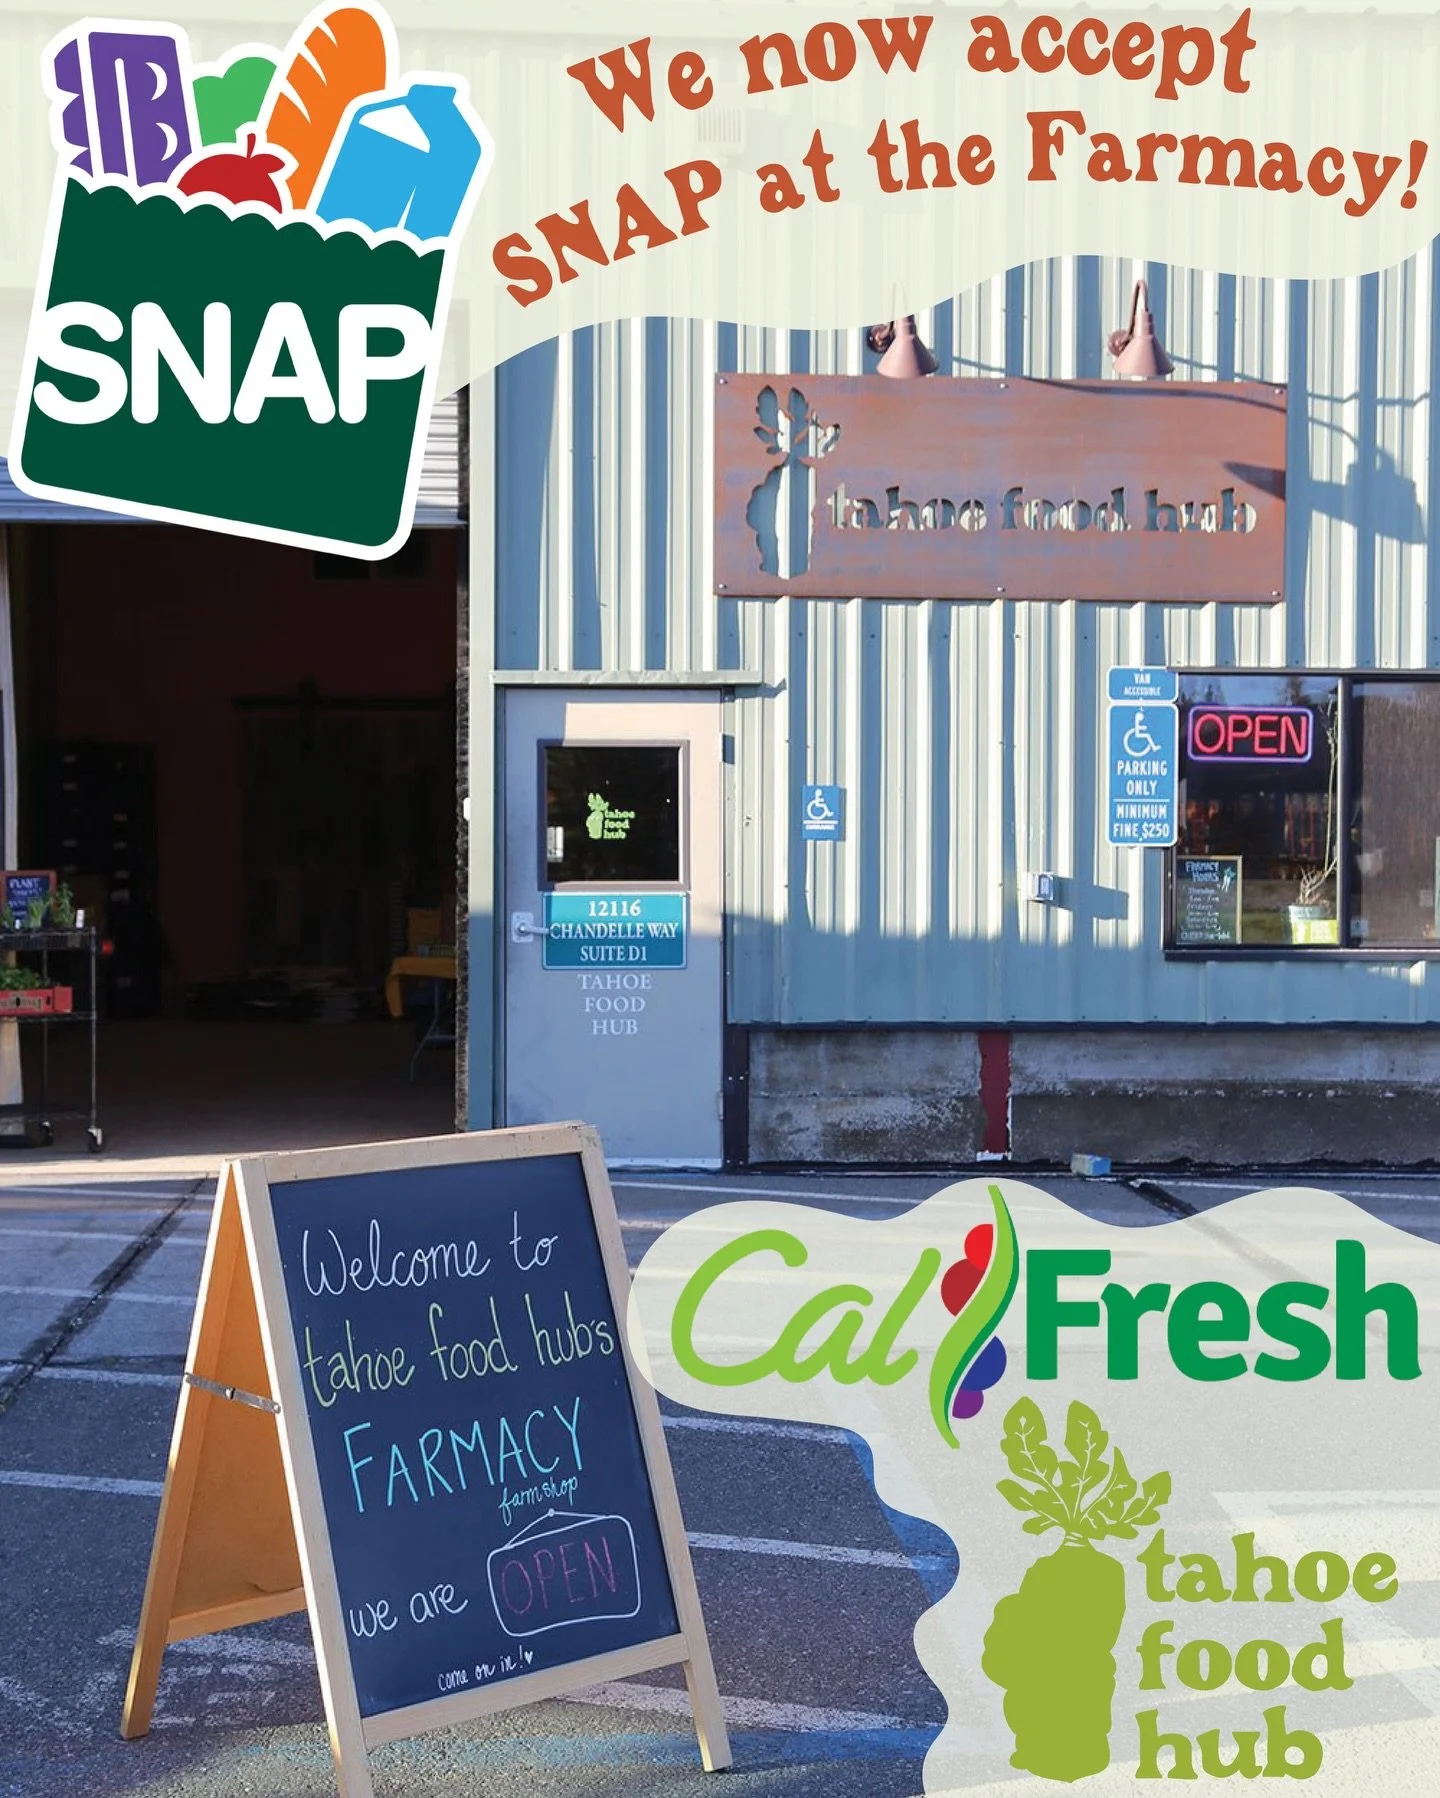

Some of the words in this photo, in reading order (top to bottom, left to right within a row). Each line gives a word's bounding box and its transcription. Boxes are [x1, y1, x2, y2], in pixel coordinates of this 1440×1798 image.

[827, 483, 987, 531] tahoe
[1000, 486, 1131, 533] food
[1144, 488, 1258, 534] hub
[1134, 674, 1151, 684] VAN
[1194, 713, 1308, 755] OPEN
[1117, 760, 1168, 776] PARKING
[1126, 780, 1157, 796] ONLY
[604, 809, 635, 819] tahoe
[1116, 804, 1168, 819] MINIMUM
[604, 819, 630, 830] food
[1113, 823, 1138, 837] FINE
[1142, 823, 1169, 839] $250
[603, 829, 627, 840] hub
[588, 899, 641, 917] 12116
[550, 923, 644, 939] CHANDELLE
[649, 922, 679, 939] WAY
[580, 946, 625, 962] SUITE
[629, 946, 647, 961] D1
[578, 974, 652, 990] TAHOE
[585, 996, 645, 1013] FOOD
[592, 1019, 638, 1036] HUB
[303, 1219, 490, 1296] Welcome
[509, 1211, 558, 1271] to
[303, 1320, 416, 1408] tahoe
[429, 1296, 518, 1384] food
[343, 1397, 583, 1514] FARMACY
[348, 1597, 398, 1638] we
[410, 1583, 468, 1623] are
[501, 1535, 618, 1615] OPEN
[437, 1669, 469, 1692] come
[475, 1663, 496, 1680] on
